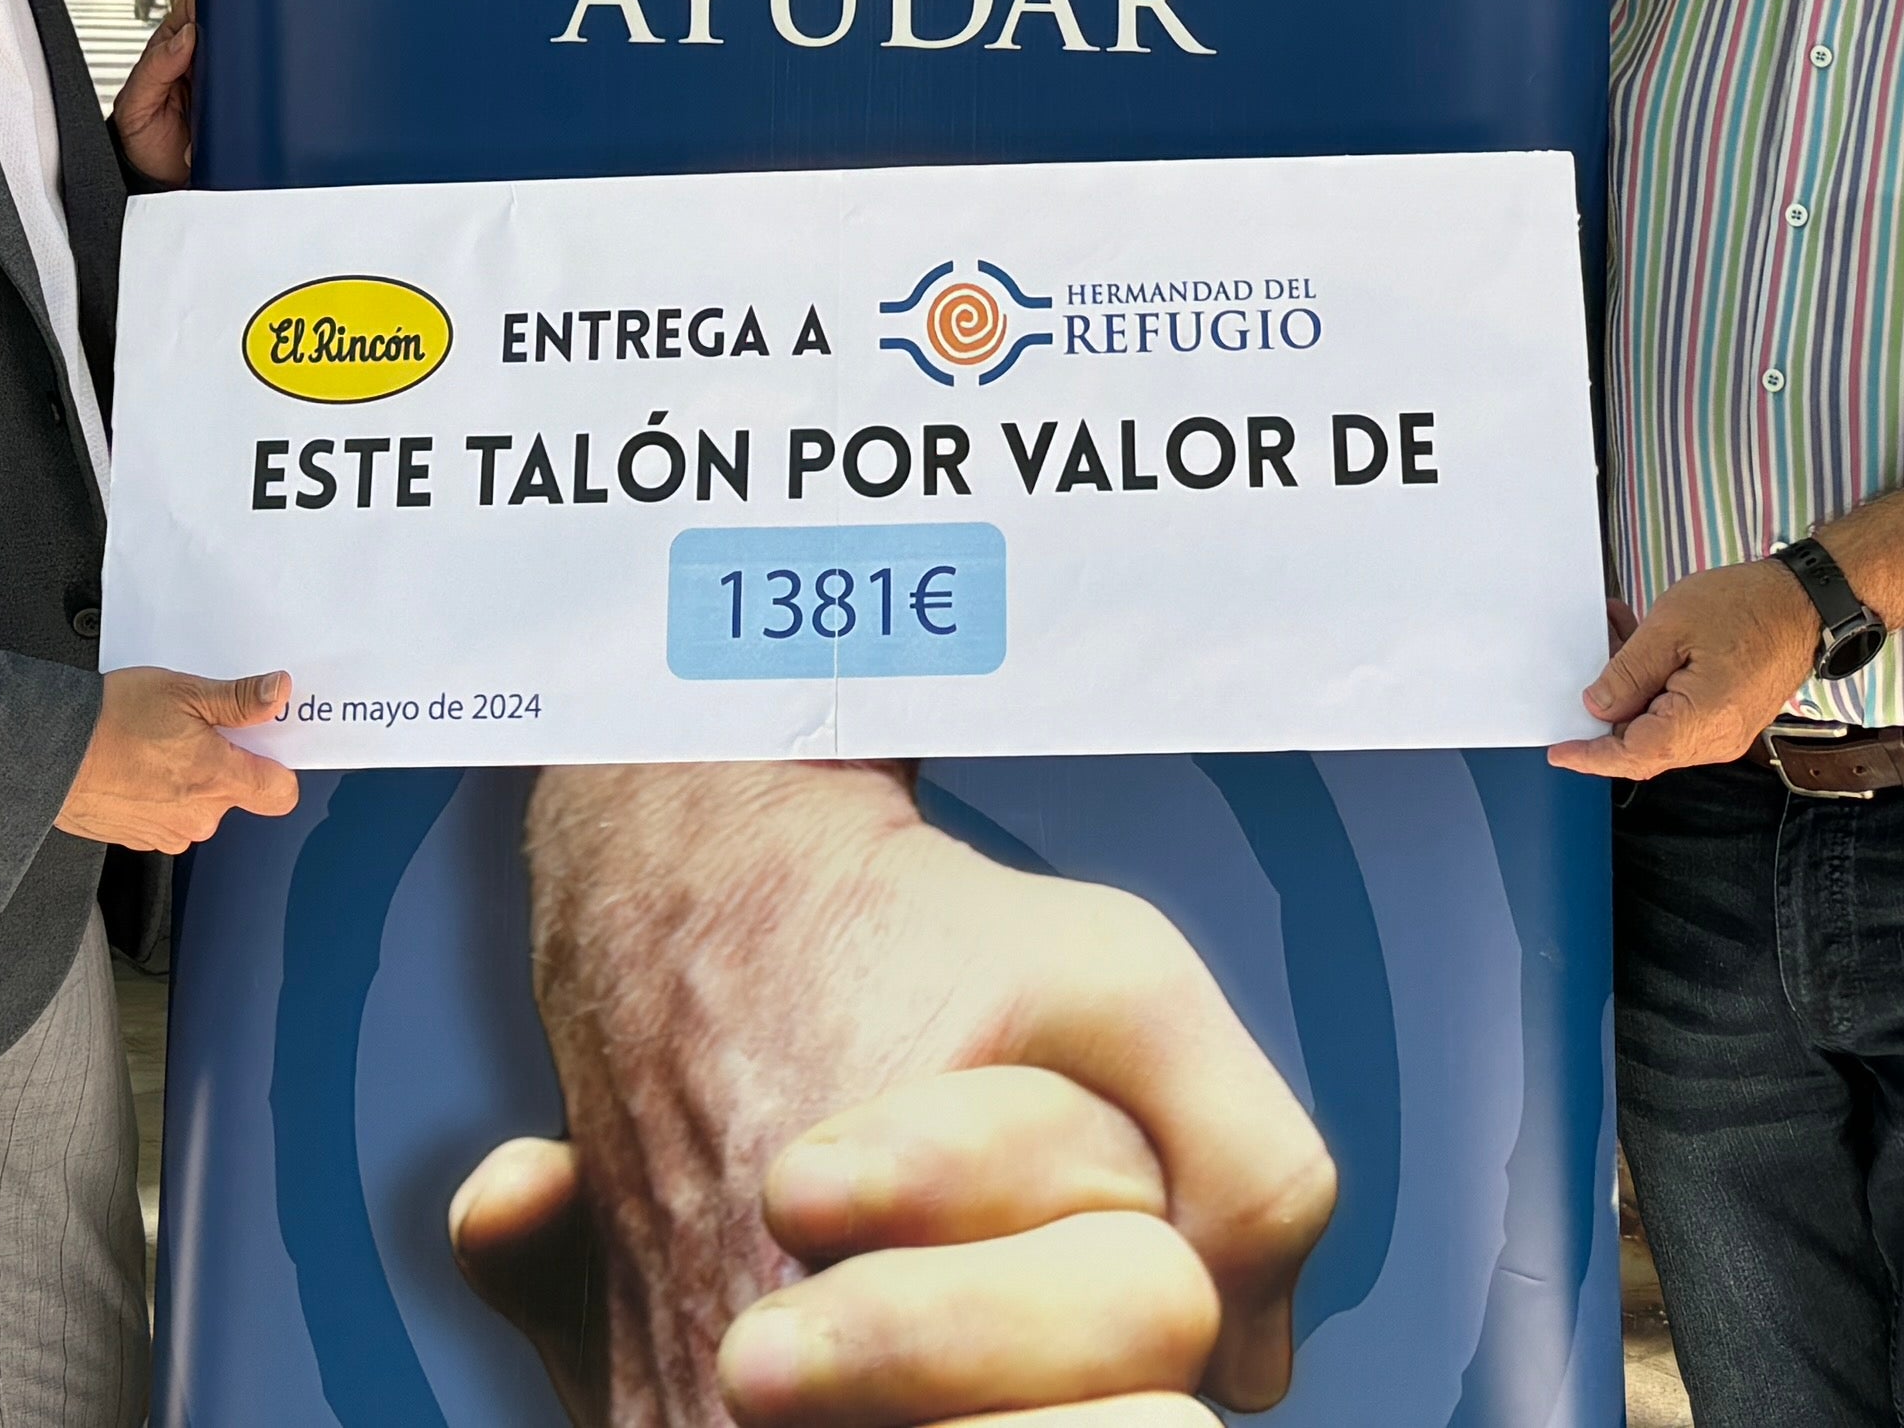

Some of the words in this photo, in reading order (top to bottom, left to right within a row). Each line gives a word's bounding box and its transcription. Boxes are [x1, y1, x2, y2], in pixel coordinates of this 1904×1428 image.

[1066, 279, 1254, 306] HERMANDAD
[1265, 277, 1318, 300] DEL
[269, 317, 305, 364] El
[307, 316, 426, 364] Rincón
[502, 304, 772, 364] ENTREGA
[792, 303, 832, 356] A
[1062, 307, 1323, 356] REFUGIO
[252, 436, 434, 511] ESTE
[466, 410, 750, 507] TALÓN
[787, 423, 972, 501] POR
[1001, 415, 1299, 496] VALOR
[1332, 411, 1440, 486] DE
[721, 565, 958, 641] 1381€
[297, 693, 333, 722] de
[341, 700, 419, 729] mayo
[428, 692, 464, 721] de
[471, 693, 543, 721] 2024
